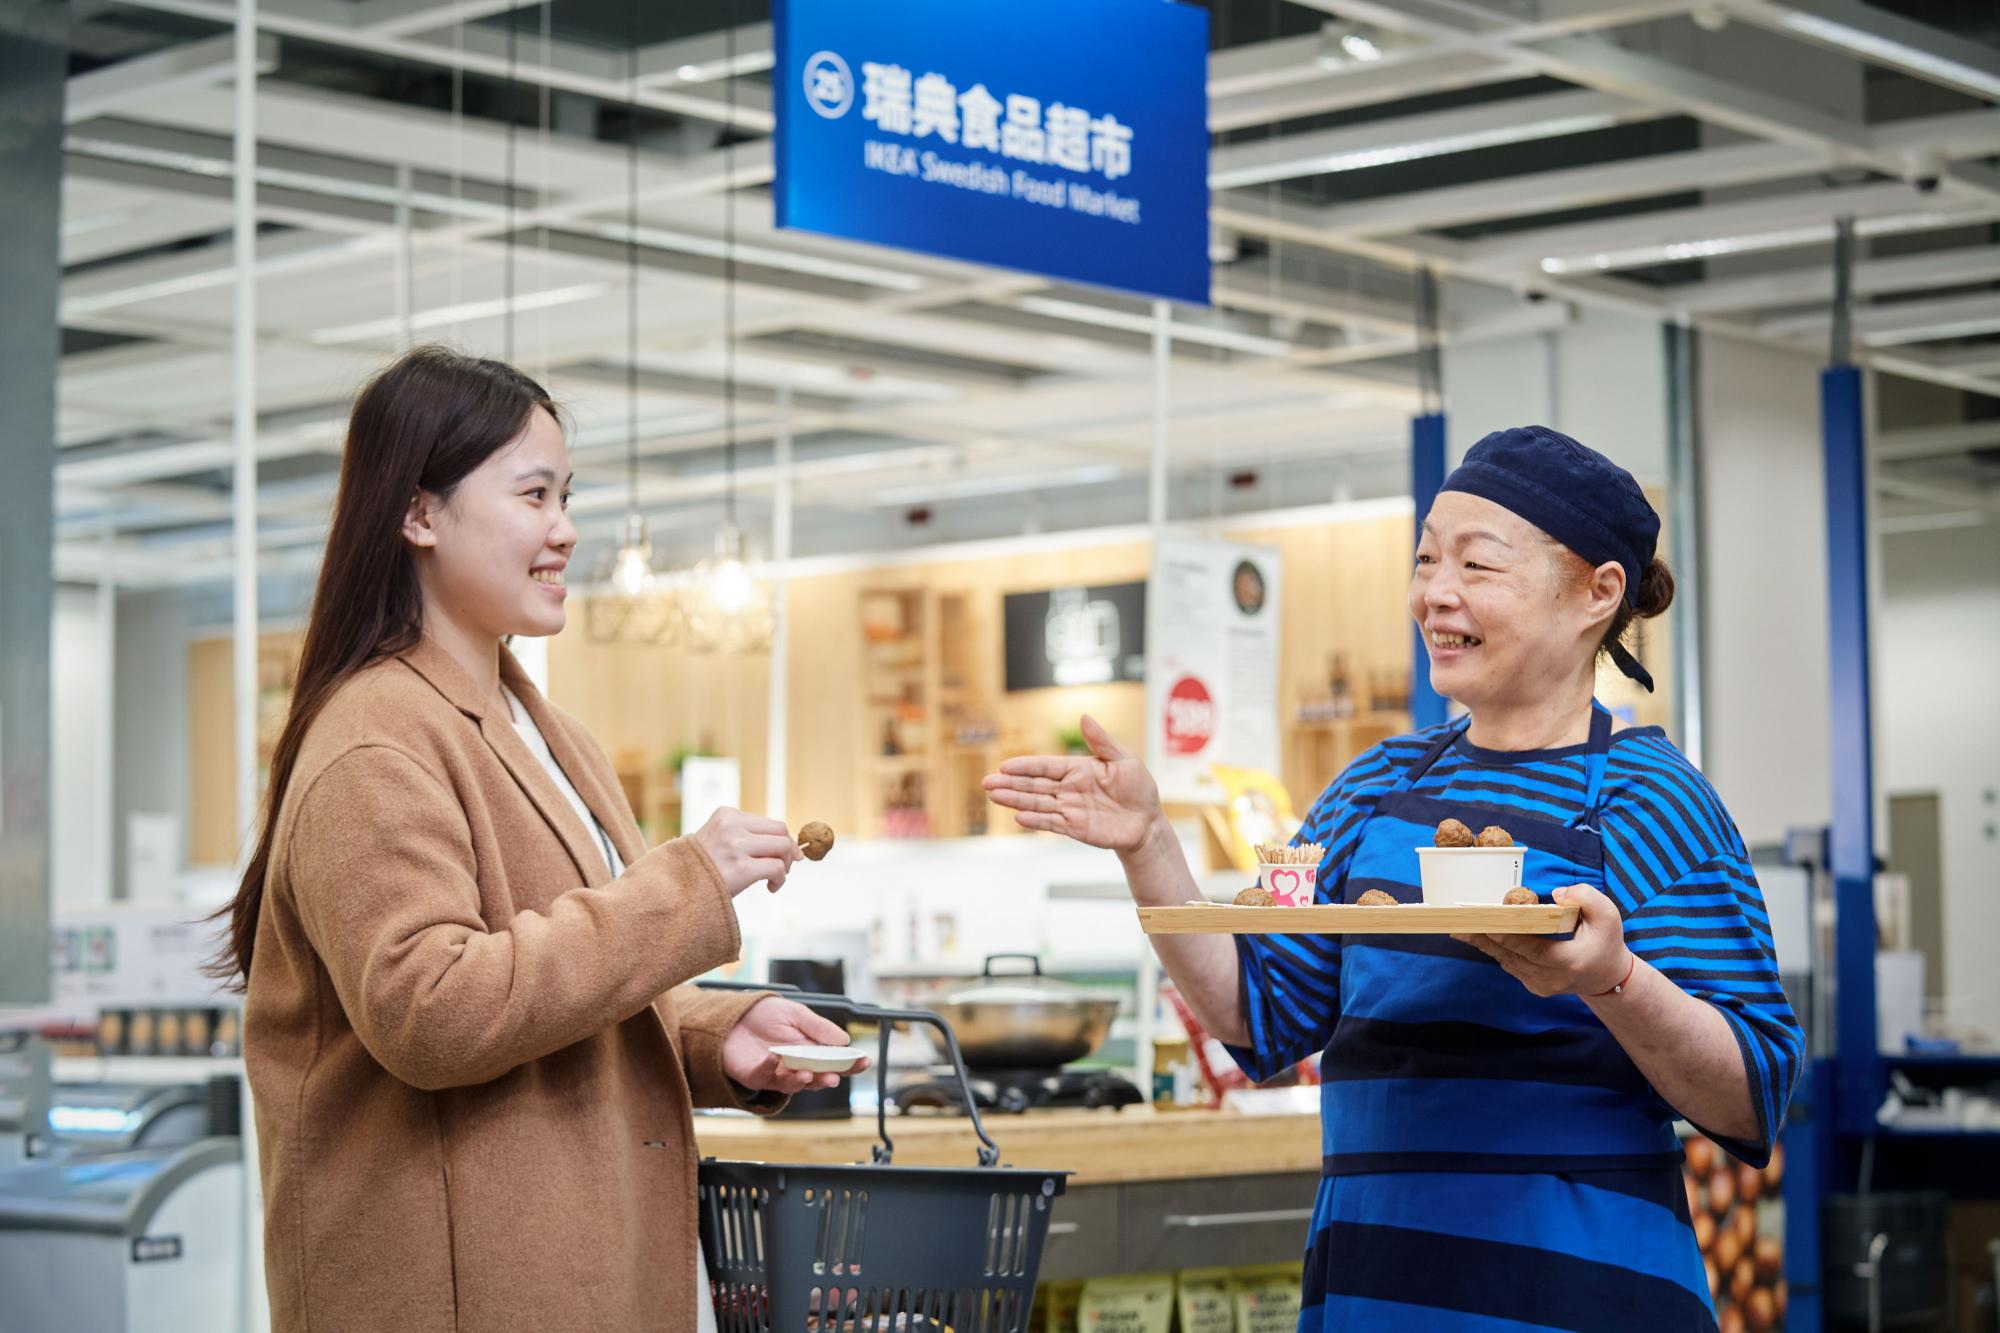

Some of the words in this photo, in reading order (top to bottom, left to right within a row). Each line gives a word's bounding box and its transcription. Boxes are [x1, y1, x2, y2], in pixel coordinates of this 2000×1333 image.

[861, 61, 1134, 180] 瑞典食品超市
[864, 139, 919, 177] IKEA
[920, 150, 1010, 196] Swedish
[1011, 169, 1067, 209] Food
[1067, 182, 1142, 225] Market
